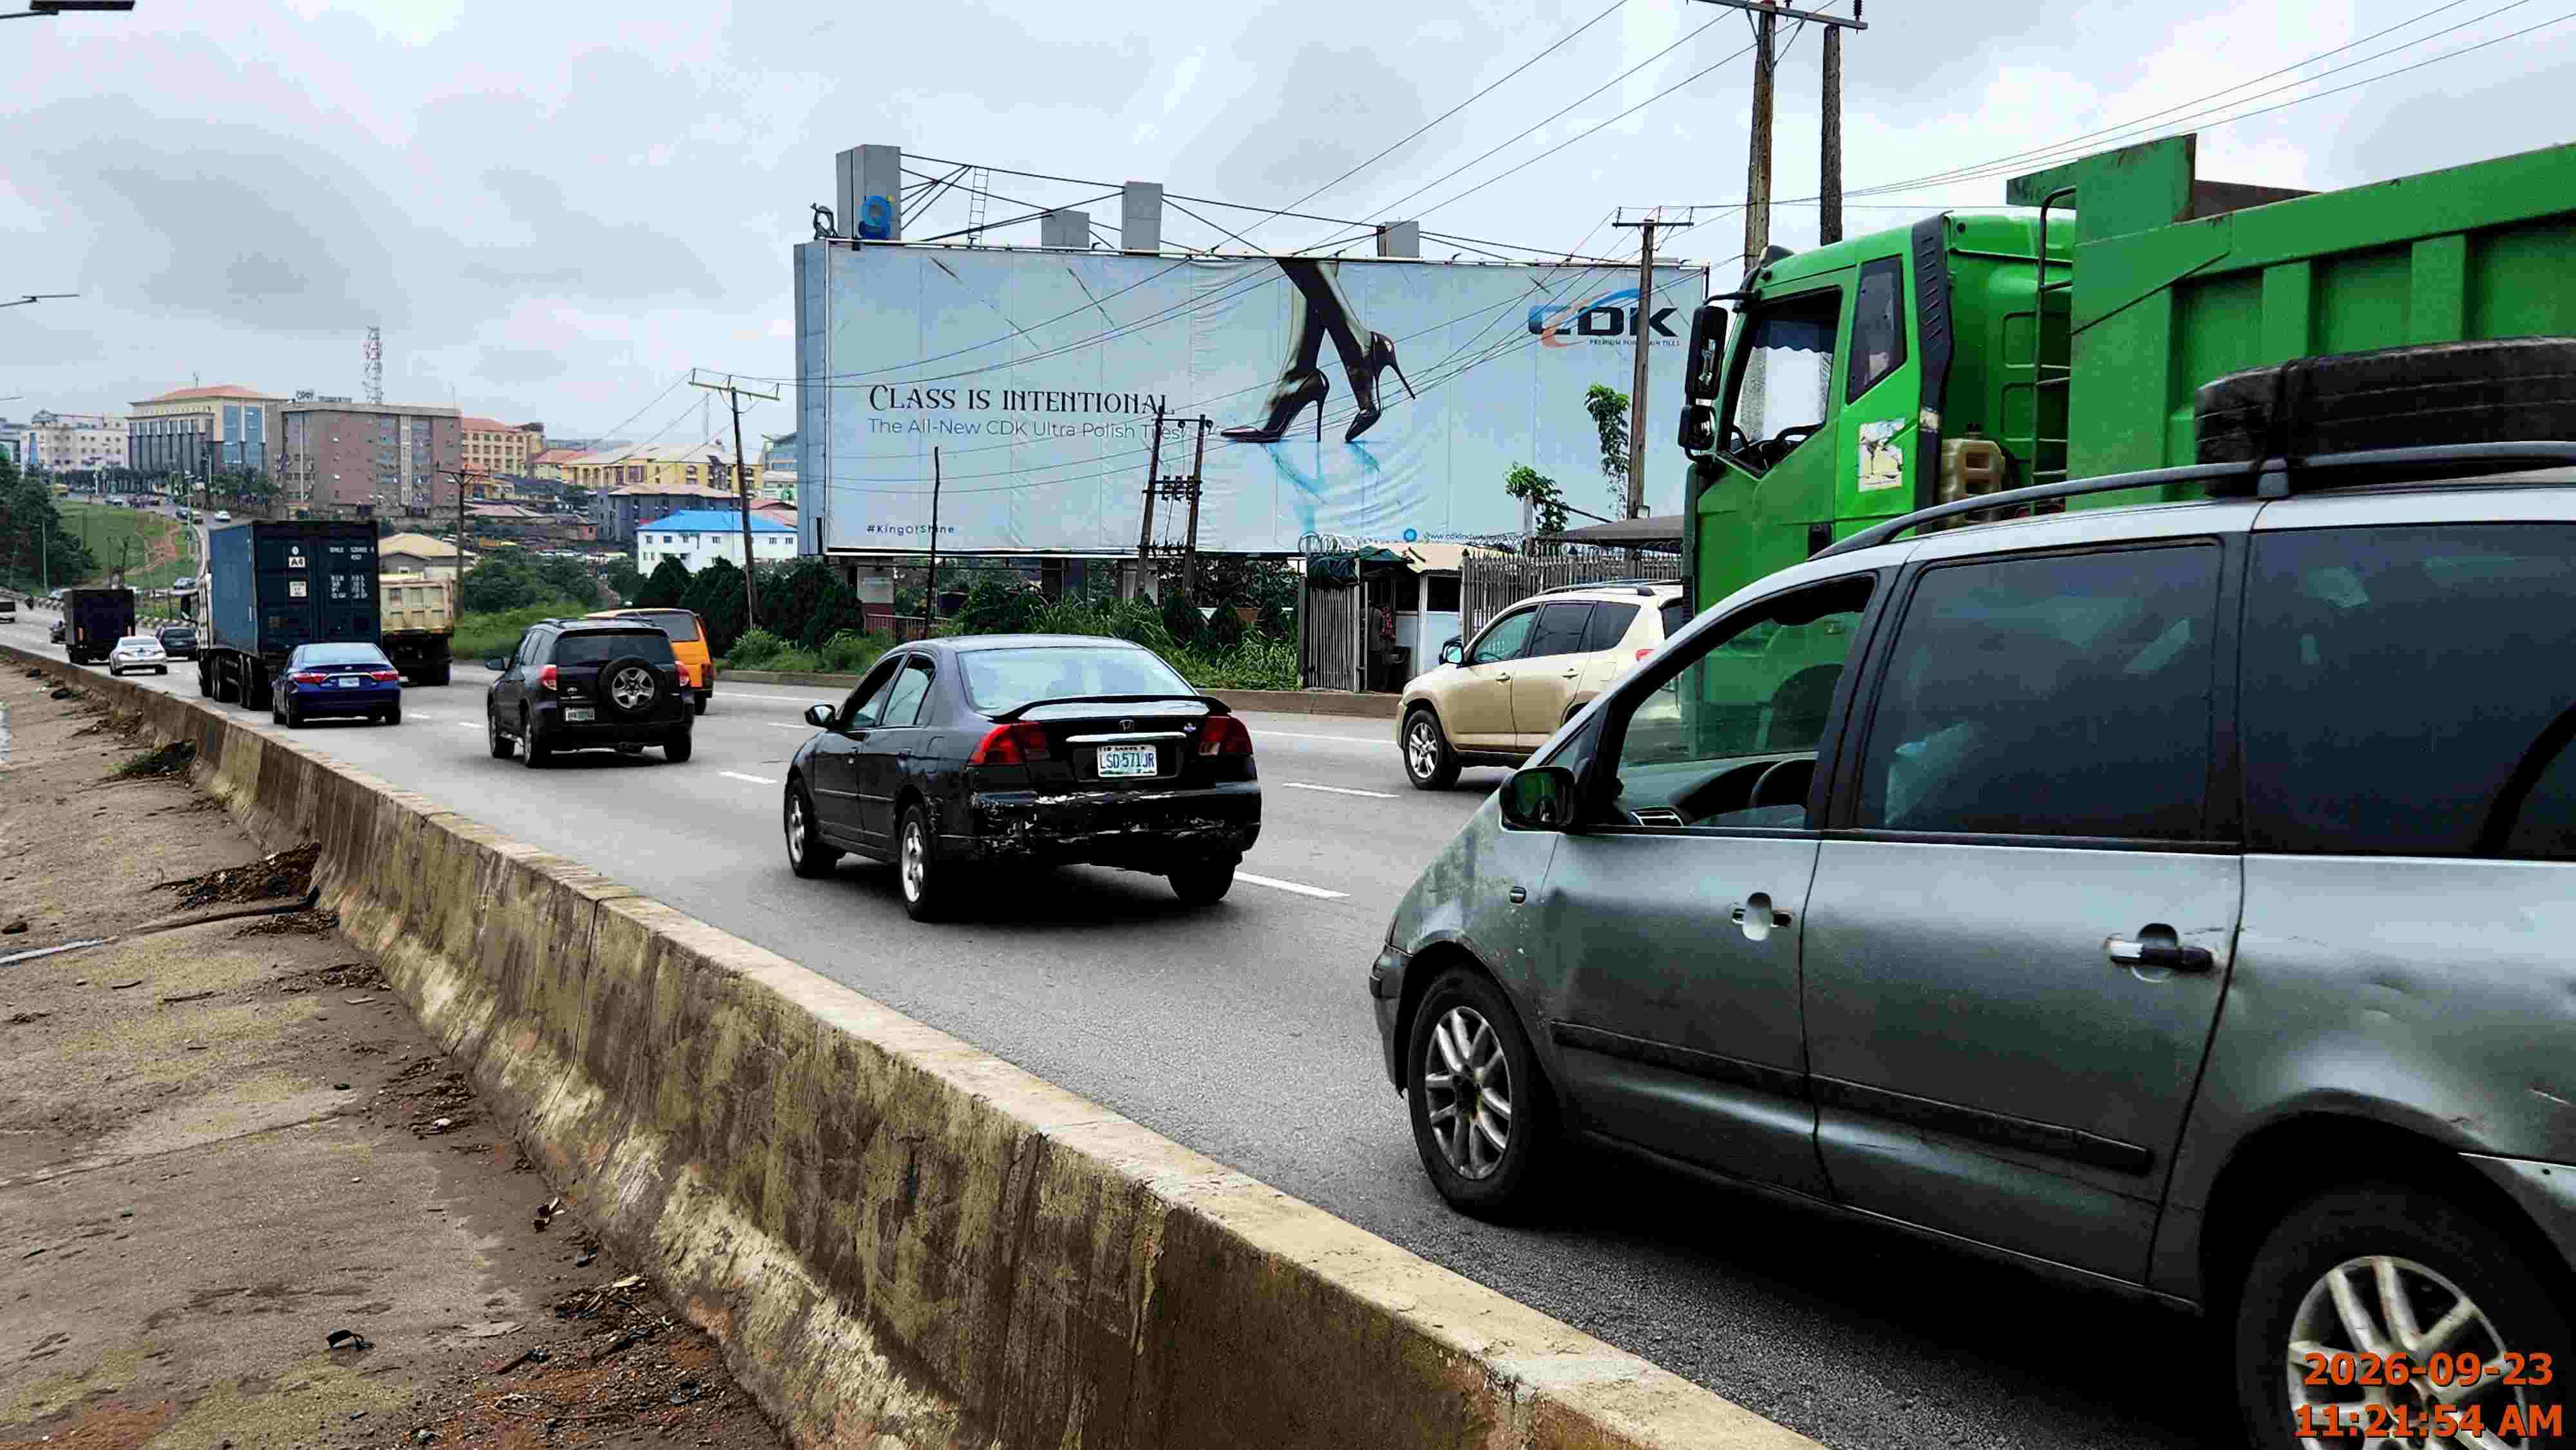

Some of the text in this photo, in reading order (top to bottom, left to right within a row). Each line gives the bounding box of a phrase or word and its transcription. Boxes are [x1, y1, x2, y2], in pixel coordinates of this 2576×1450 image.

[869, 384, 1175, 415] CLASS IS INTENTIONAL
[869, 418, 902, 433] The
[907, 419, 980, 434] All-New
[986, 420, 1027, 435] CDK
[1034, 422, 1075, 437] Ultra
[1083, 423, 1135, 438] Polish
